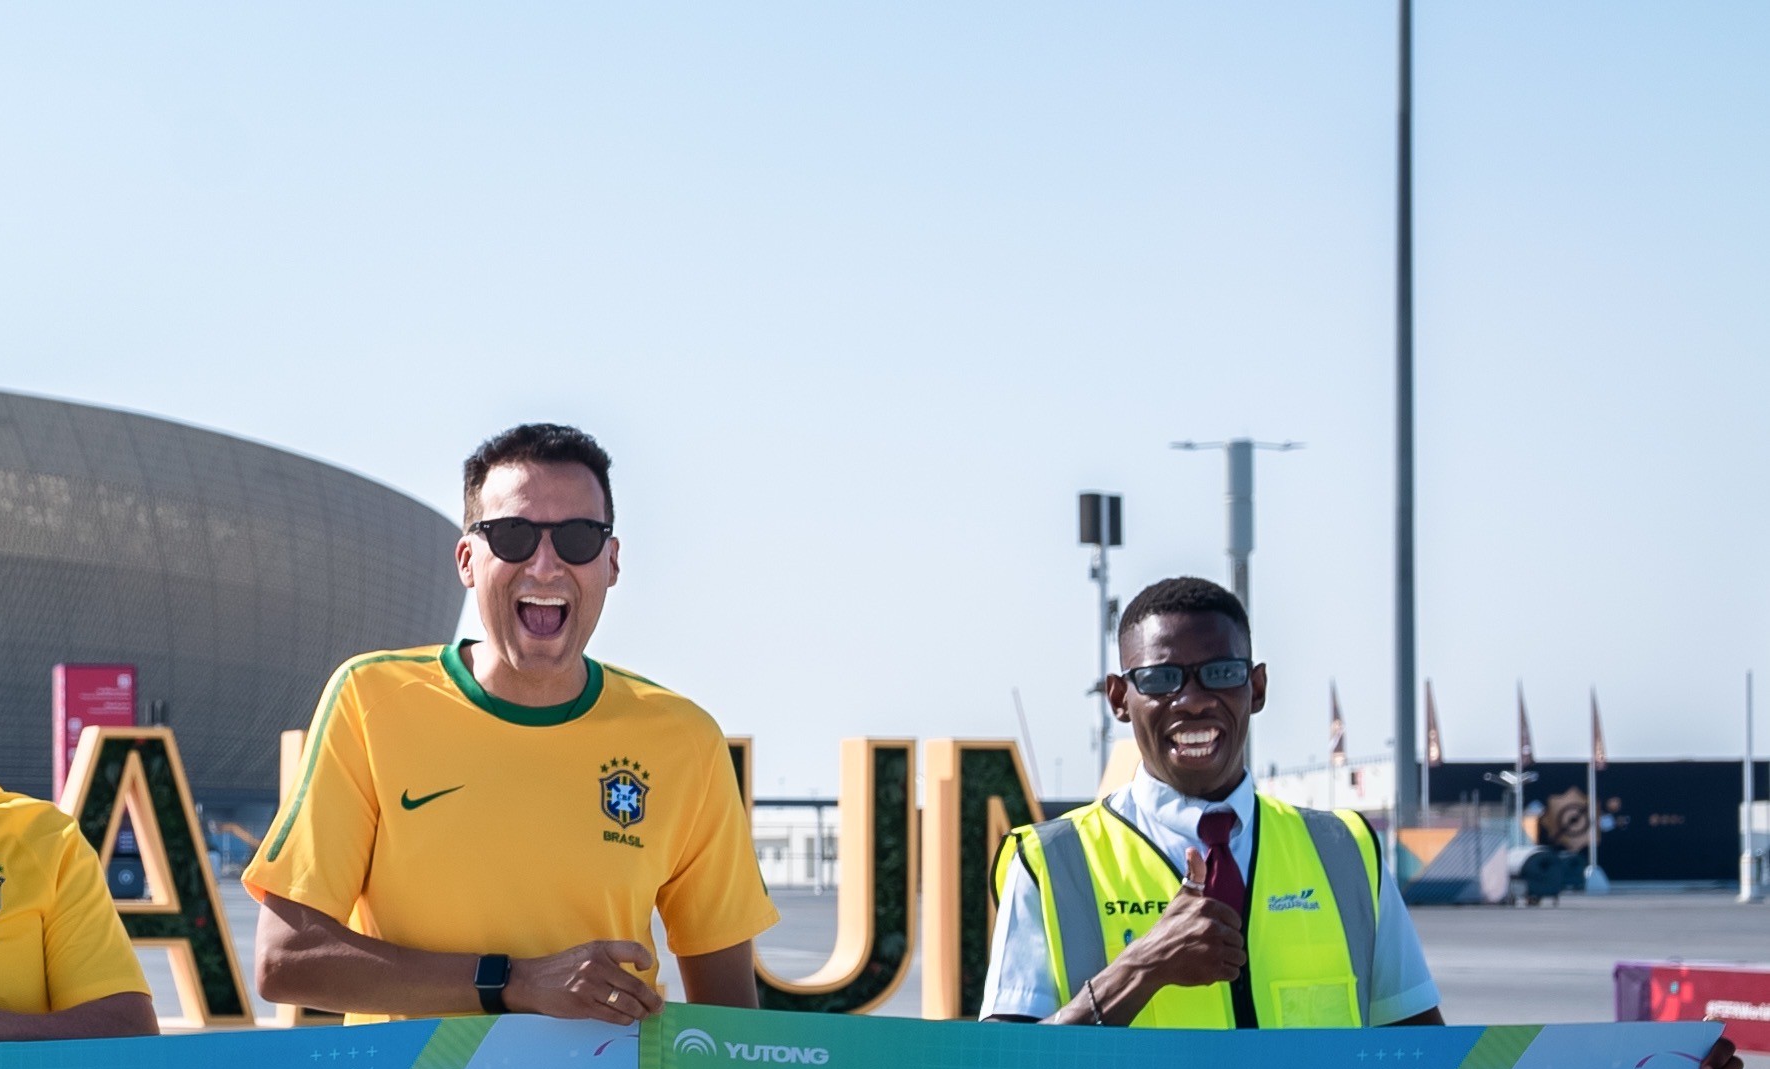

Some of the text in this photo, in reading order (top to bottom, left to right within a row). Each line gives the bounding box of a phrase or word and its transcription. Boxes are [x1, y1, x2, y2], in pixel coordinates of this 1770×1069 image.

[603, 830, 644, 848] BRASIL
[1104, 900, 1169, 915] STAFF
[724, 1041, 830, 1065] YUTONG
